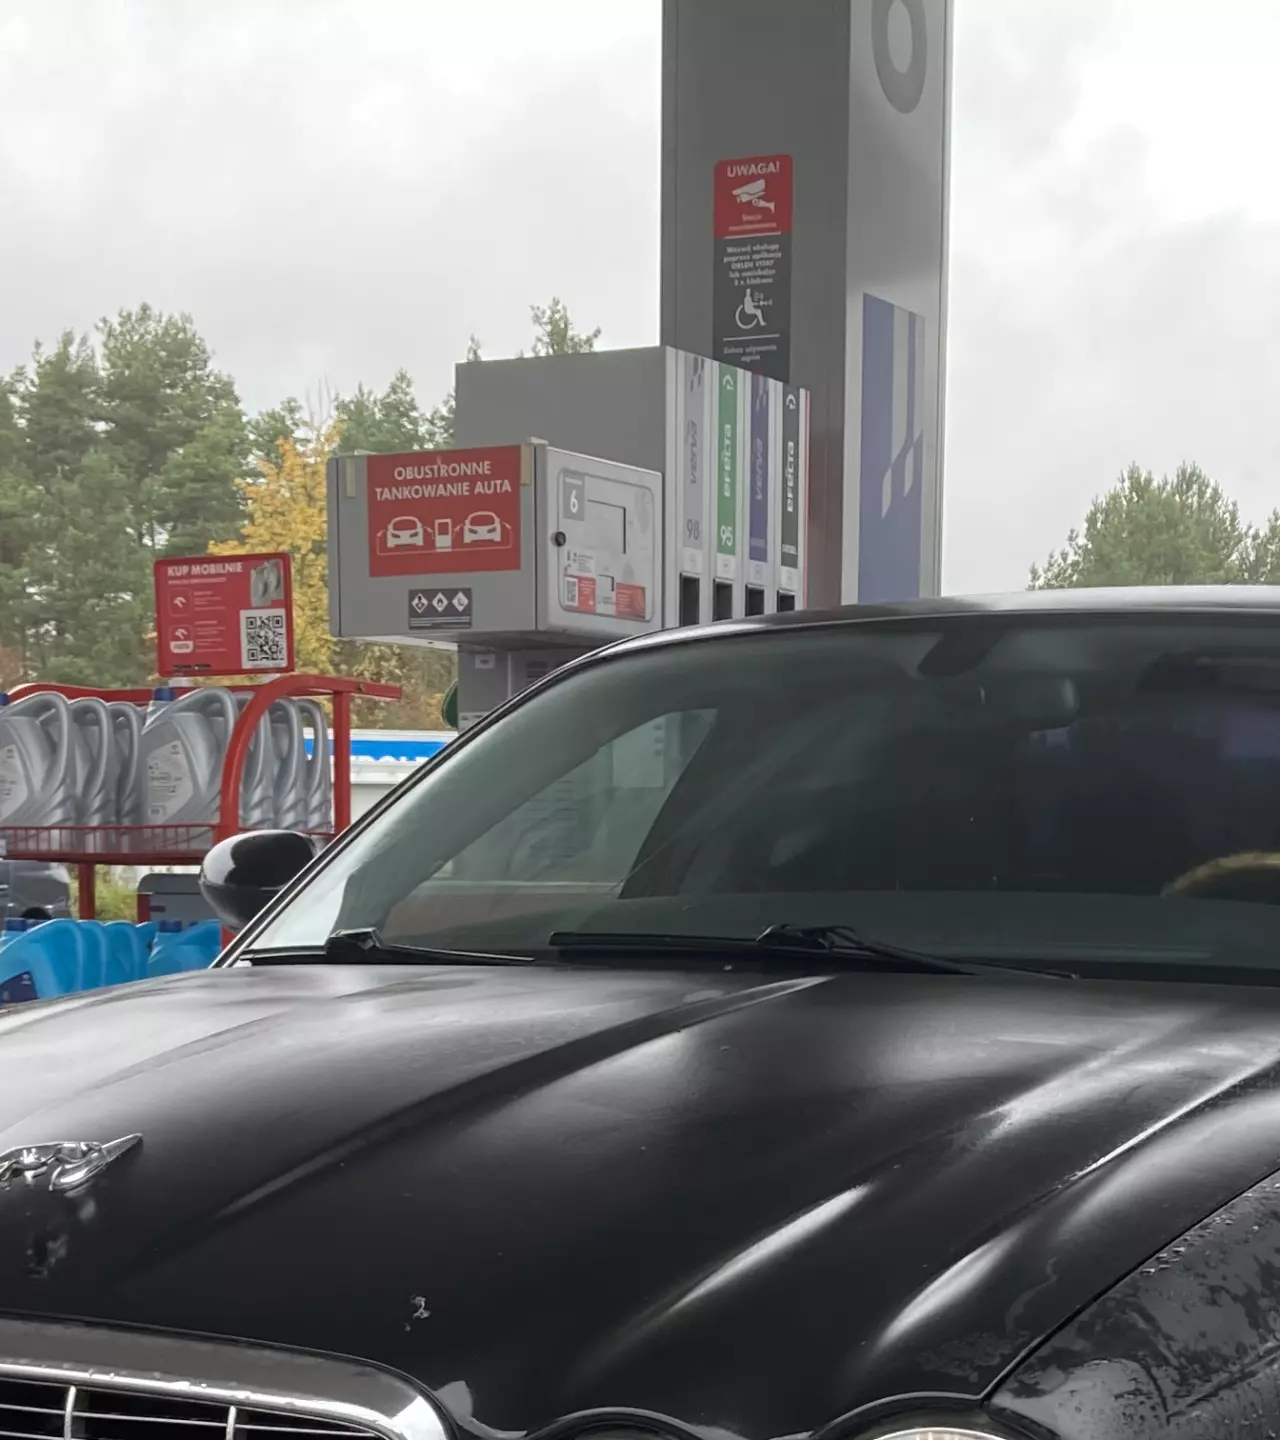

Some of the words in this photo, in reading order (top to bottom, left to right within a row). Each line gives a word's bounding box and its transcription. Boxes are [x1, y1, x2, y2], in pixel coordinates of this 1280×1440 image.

[727, 160, 780, 178] UWAGA!
[394, 460, 492, 481] OBUSTRONNE
[375, 482, 470, 501] TANKOWANIE
[474, 479, 512, 495] AUTA
[570, 489, 579, 514] 6
[686, 518, 700, 541] 98
[720, 525, 733, 547] 95
[167, 565, 189, 577] KUP
[191, 562, 244, 575] MOBILNIE
